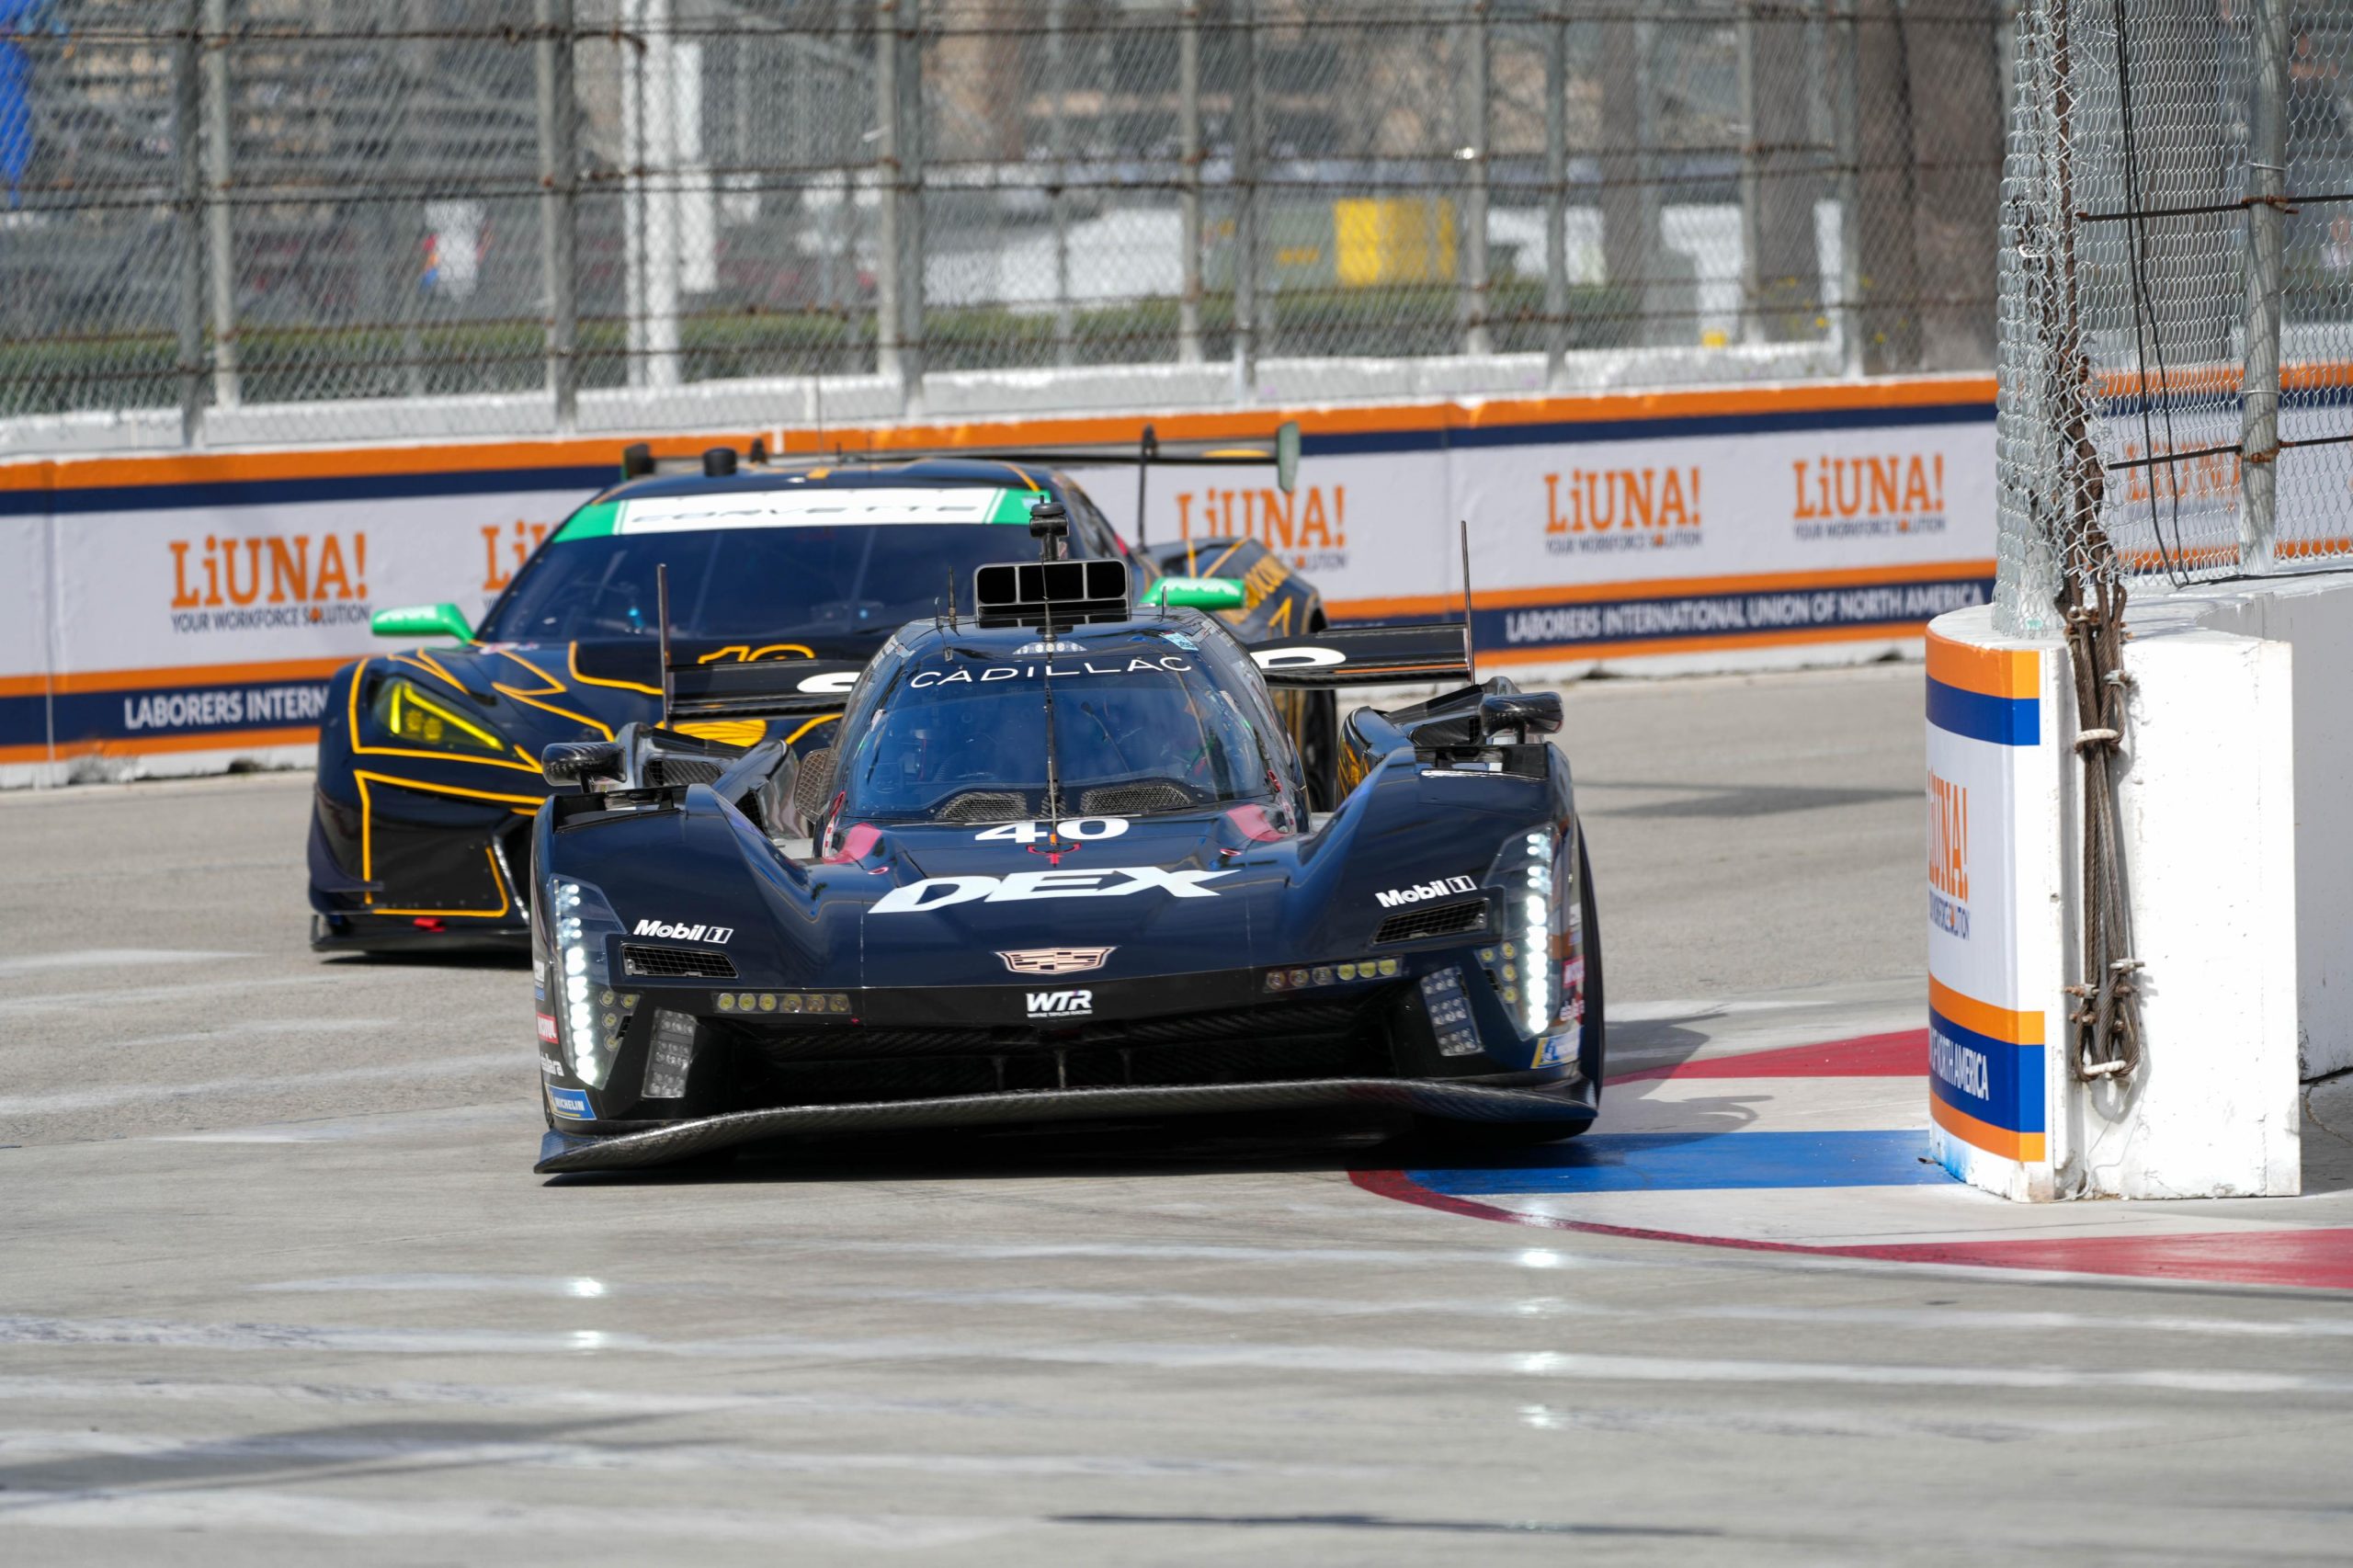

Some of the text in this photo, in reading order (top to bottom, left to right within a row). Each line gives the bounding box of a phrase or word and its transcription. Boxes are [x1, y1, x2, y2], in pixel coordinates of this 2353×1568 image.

[1544, 467, 1700, 533] LiUNA!
[1793, 454, 1944, 519] LiUNA!
[169, 531, 367, 608] LiUNA!
[1506, 584, 1984, 642] LABORERS INTERNATIONAL UNION OF NORTH AMERICA
[911, 657, 1191, 687] CADILLAC
[124, 691, 243, 730] LABORERS
[975, 818, 1129, 843] 40
[868, 867, 1241, 914] DEX
[1375, 881, 1450, 907] Mobil
[633, 919, 707, 940] Mobil
[1026, 990, 1093, 1012] WTR
